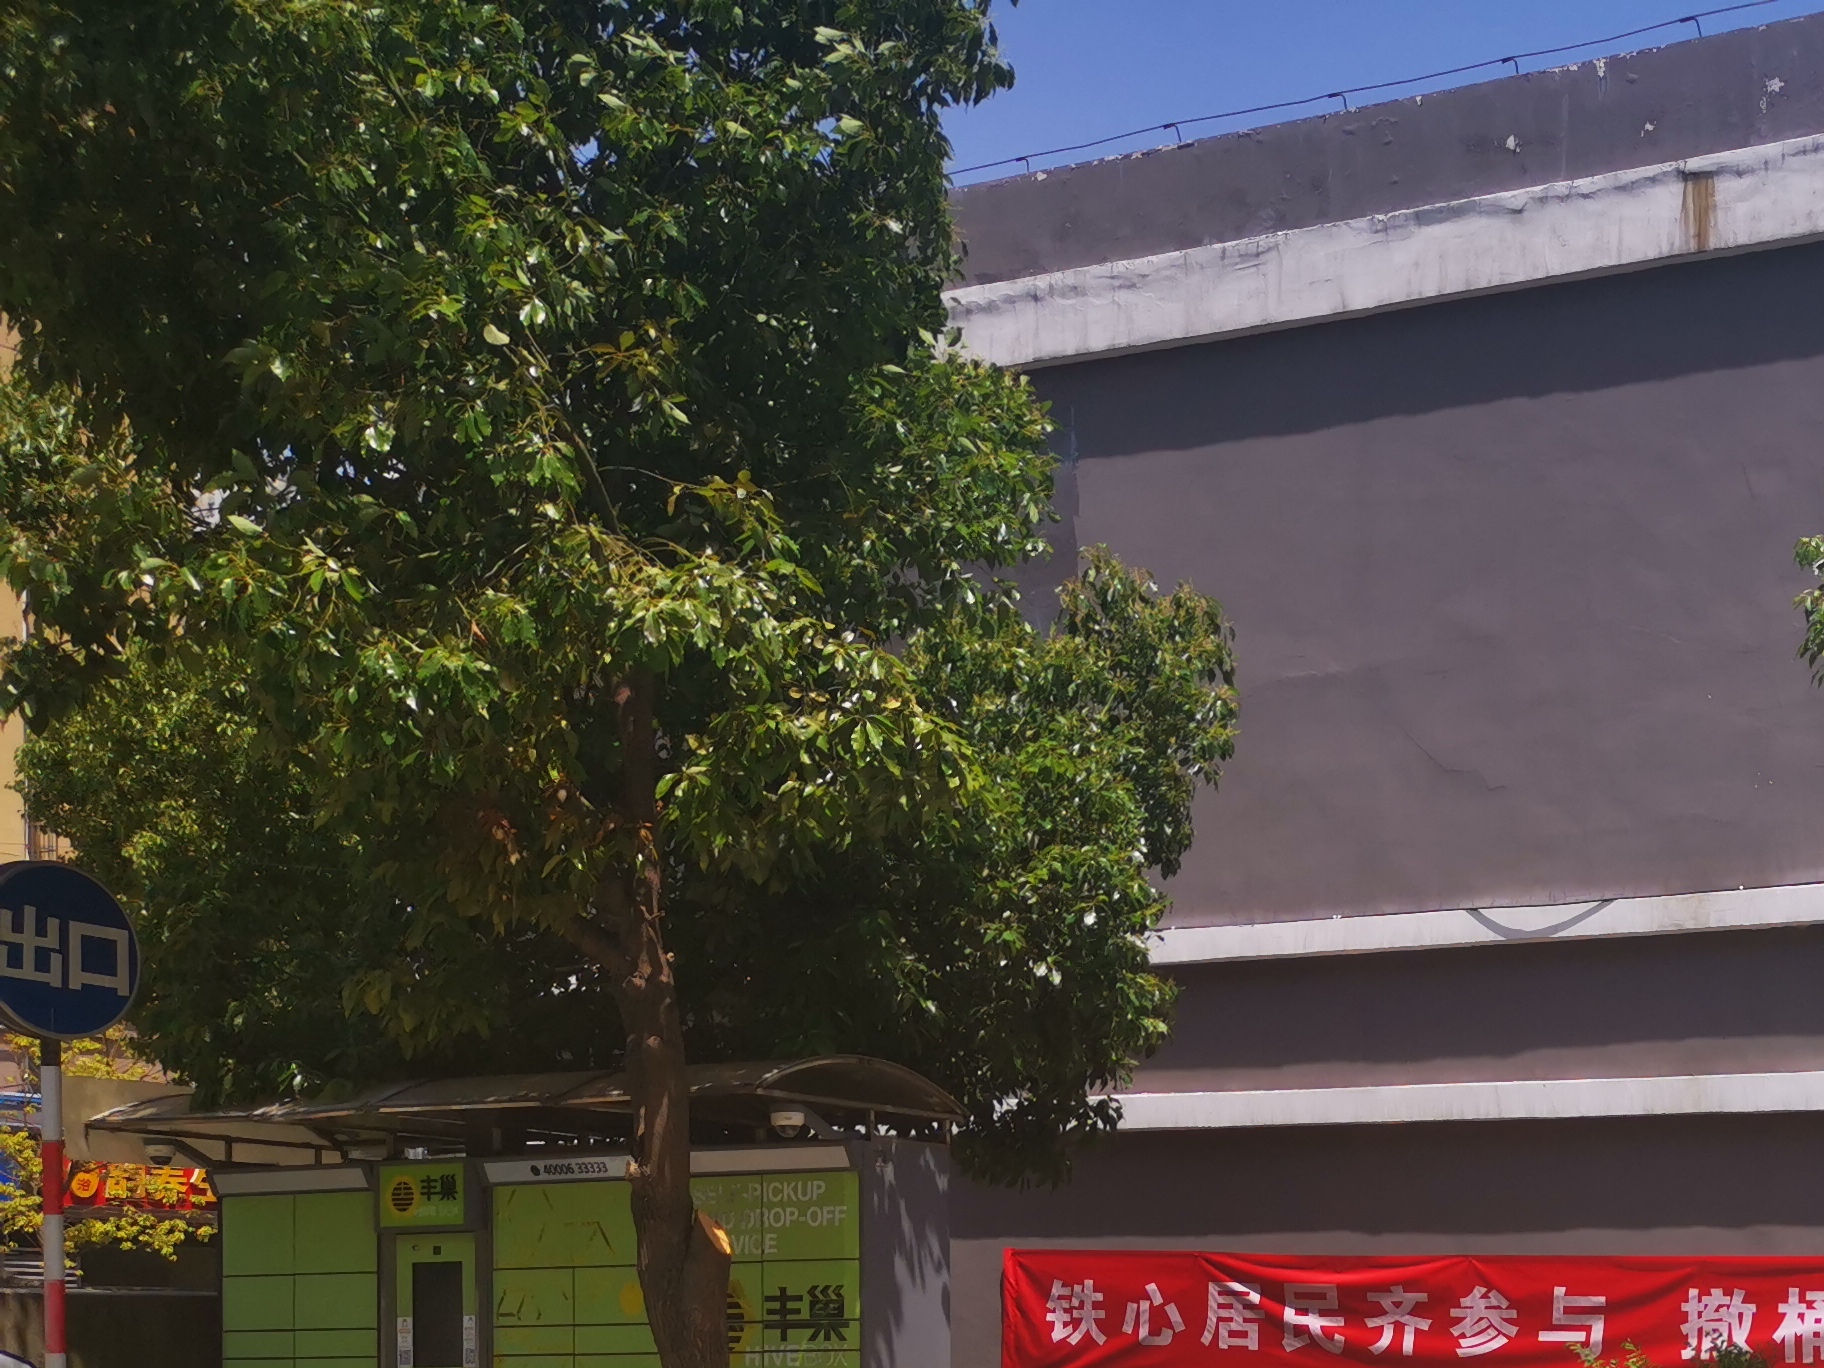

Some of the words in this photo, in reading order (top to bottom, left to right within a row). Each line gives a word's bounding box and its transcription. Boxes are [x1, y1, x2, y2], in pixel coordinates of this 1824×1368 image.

[0, 905, 130, 997] 出口
[420, 1174, 458, 1202] 丰巢
[543, 1162, 575, 1176] 40006
[575, 1161, 608, 1174] 33333
[764, 1284, 850, 1342] 丰巢
[1045, 1278, 1607, 1359] 铁心居民齐参与
